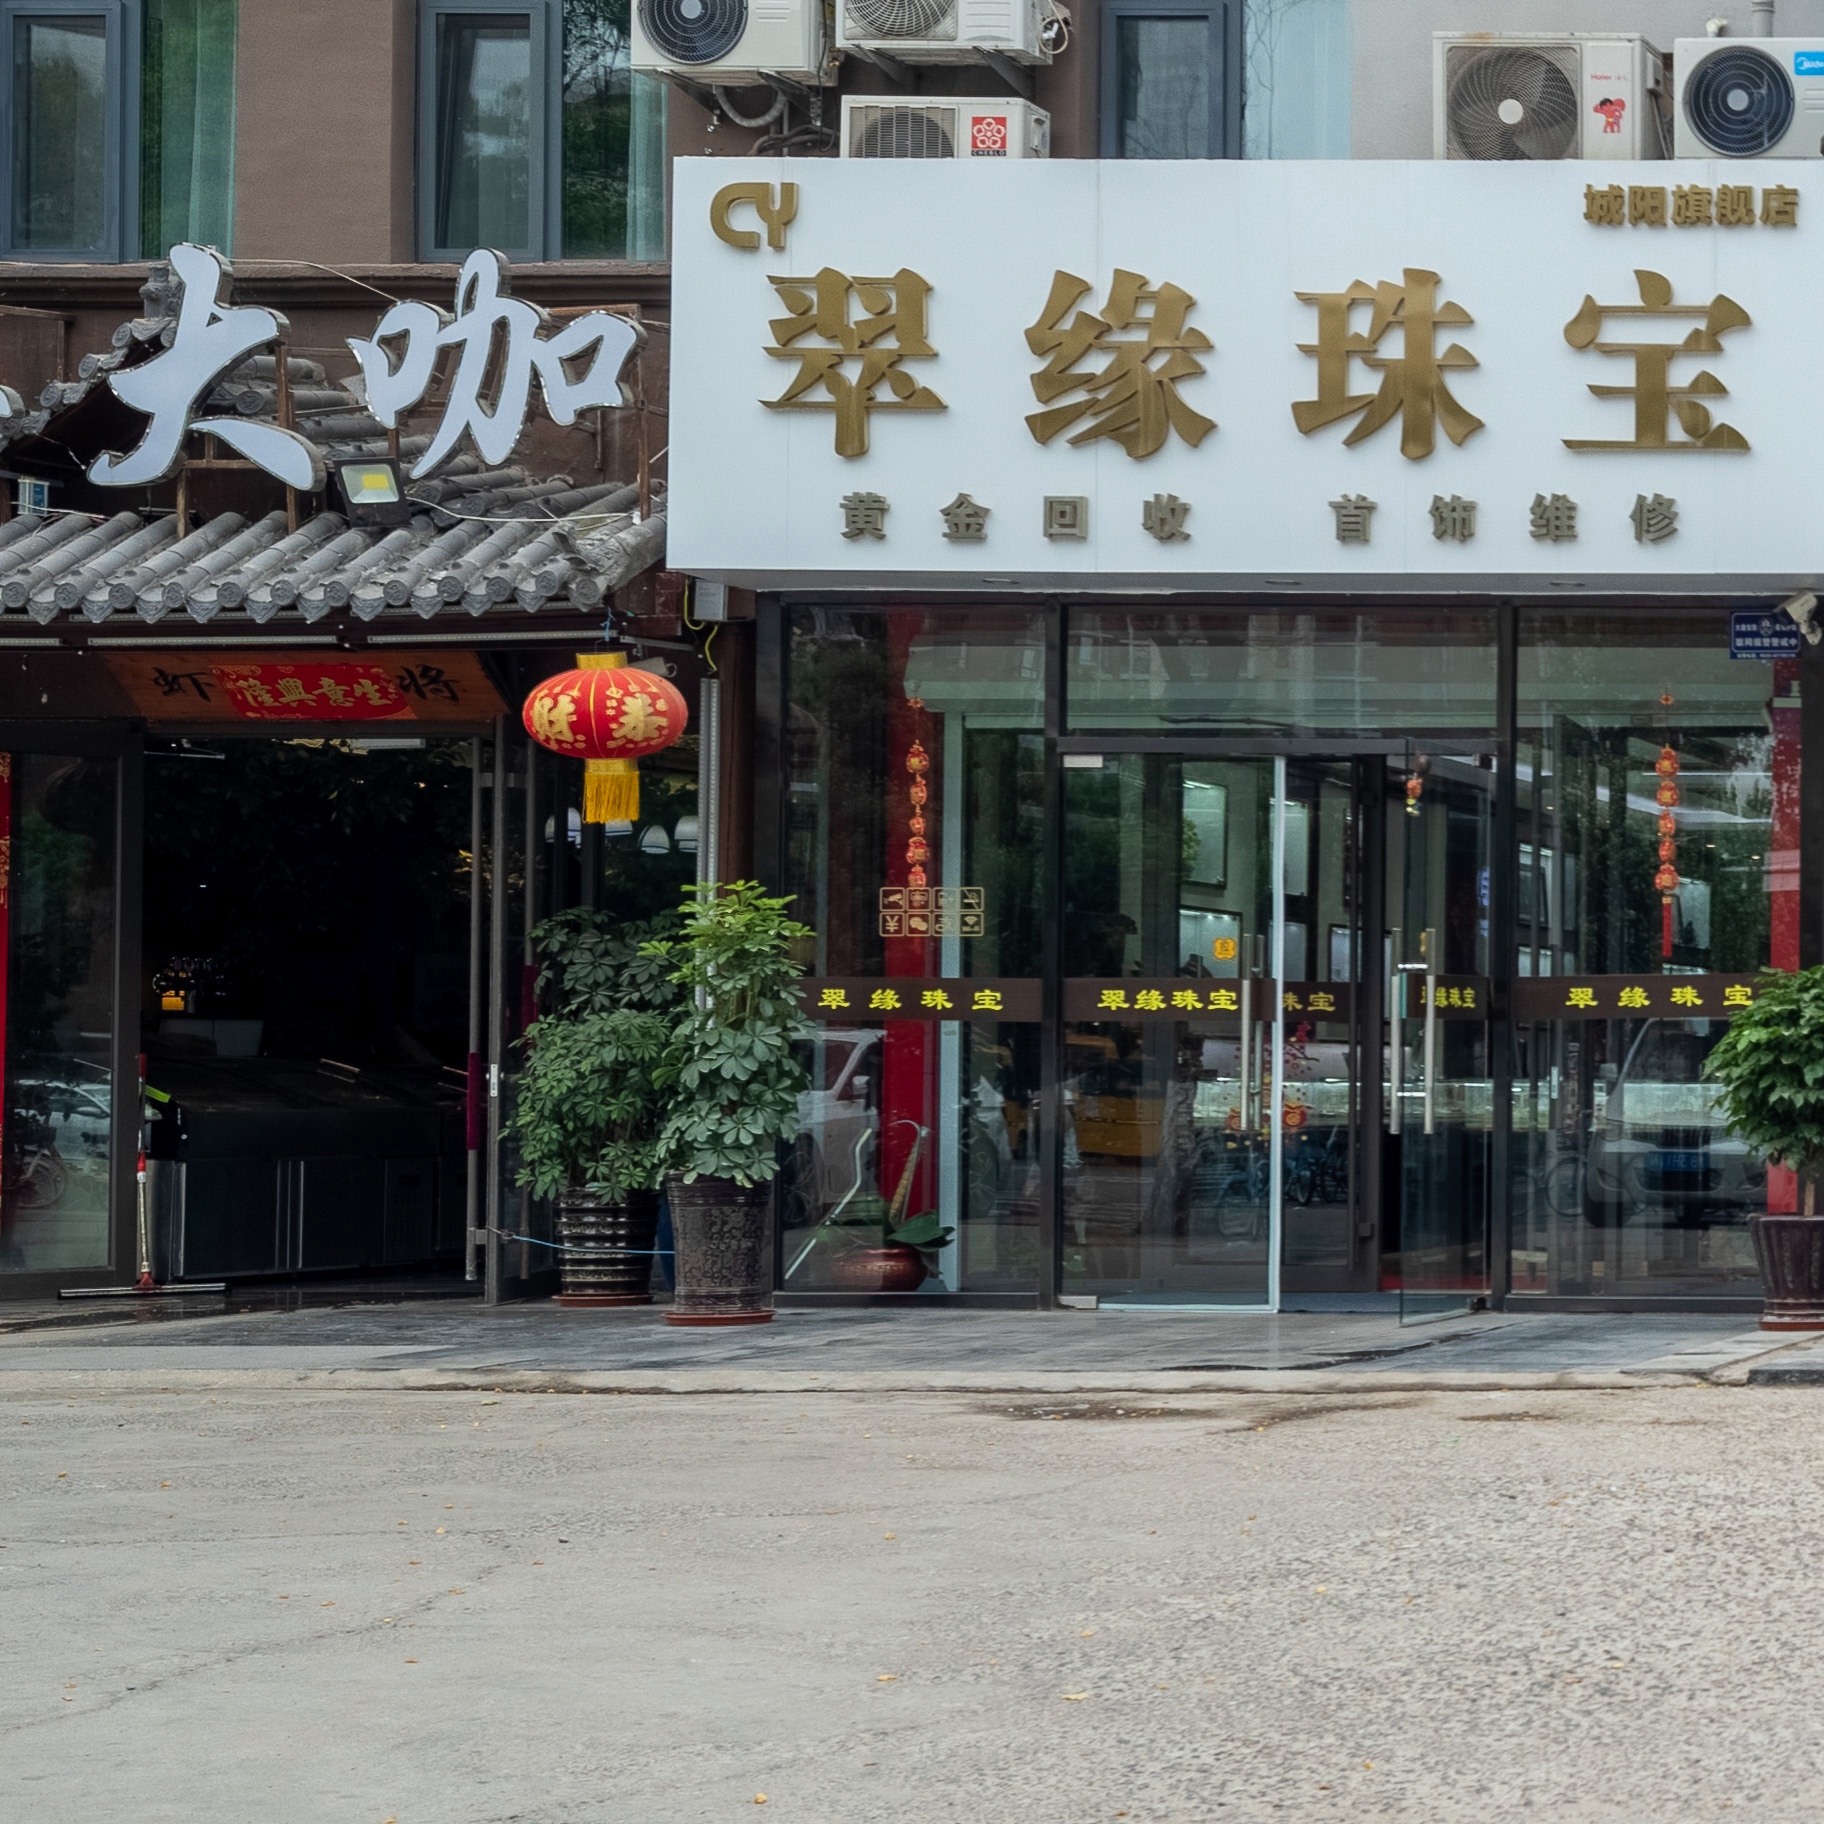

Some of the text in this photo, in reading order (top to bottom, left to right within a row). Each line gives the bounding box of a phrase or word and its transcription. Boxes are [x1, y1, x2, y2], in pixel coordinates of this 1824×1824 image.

[1583, 184, 1799, 227] 城阳旗舰店
[0, 242, 649, 490] 大咖
[757, 266, 1754, 460] 翠缘珠宝
[839, 491, 1681, 545] 黄金回收 首饰维修
[818, 988, 1004, 1011] 翠缘珠宝
[1098, 988, 1239, 1011] 翠缘珠宝
[1420, 985, 1476, 1009] 缘珠宝
[1565, 984, 1754, 1008] 翠缘珠宝
